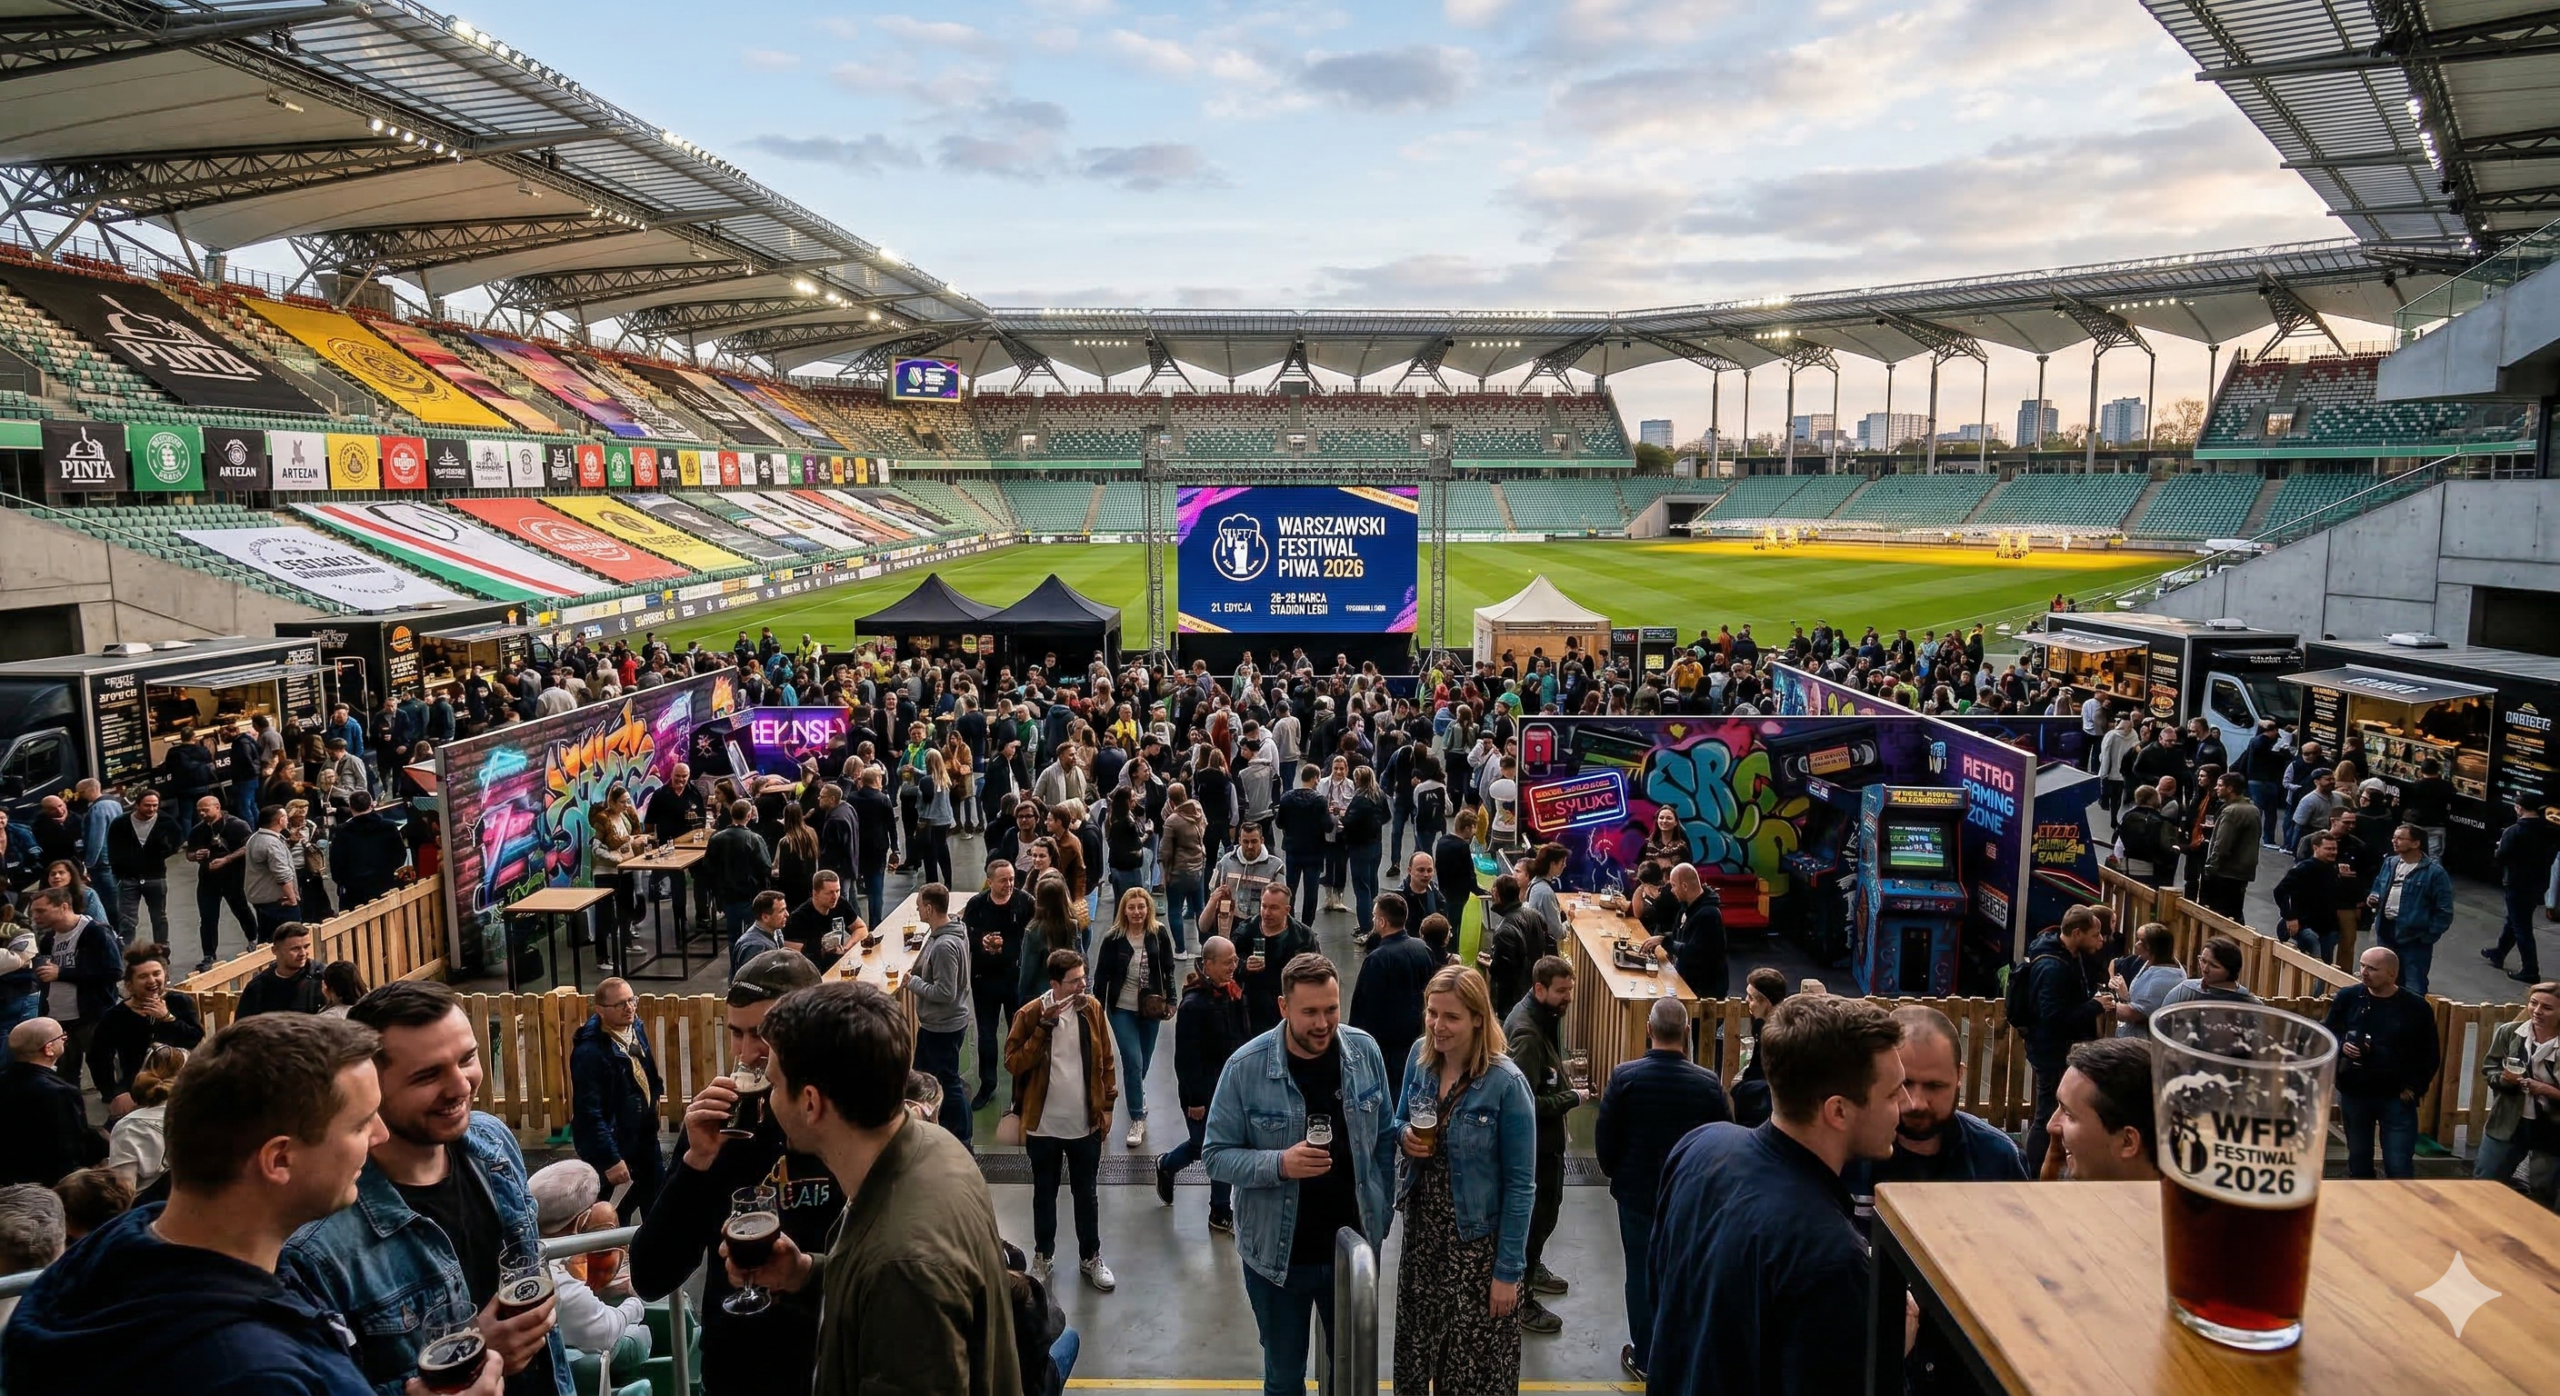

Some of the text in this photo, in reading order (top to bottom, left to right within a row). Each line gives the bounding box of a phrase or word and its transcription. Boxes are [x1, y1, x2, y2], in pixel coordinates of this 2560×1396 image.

[111, 338, 263, 376] PINTA
[60, 460, 115, 479] PINTA
[219, 466, 257, 478] ARTEZAN
[282, 467, 318, 479] ARTEZAN
[1277, 516, 1386, 536] WARSZAWSKI
[1278, 537, 1359, 557] FESTIWAL
[1278, 558, 1365, 578] PIWA 2026
[1298, 592, 1328, 604] MARCA
[1270, 604, 1306, 615] STADION
[1963, 753, 2014, 793] RETRO
[1967, 802, 2004, 837] ZONE
[2211, 1110, 2297, 1147] WFP
[2214, 1143, 2297, 1167] FESTIWAL
[2214, 1162, 2296, 1195] 2026
